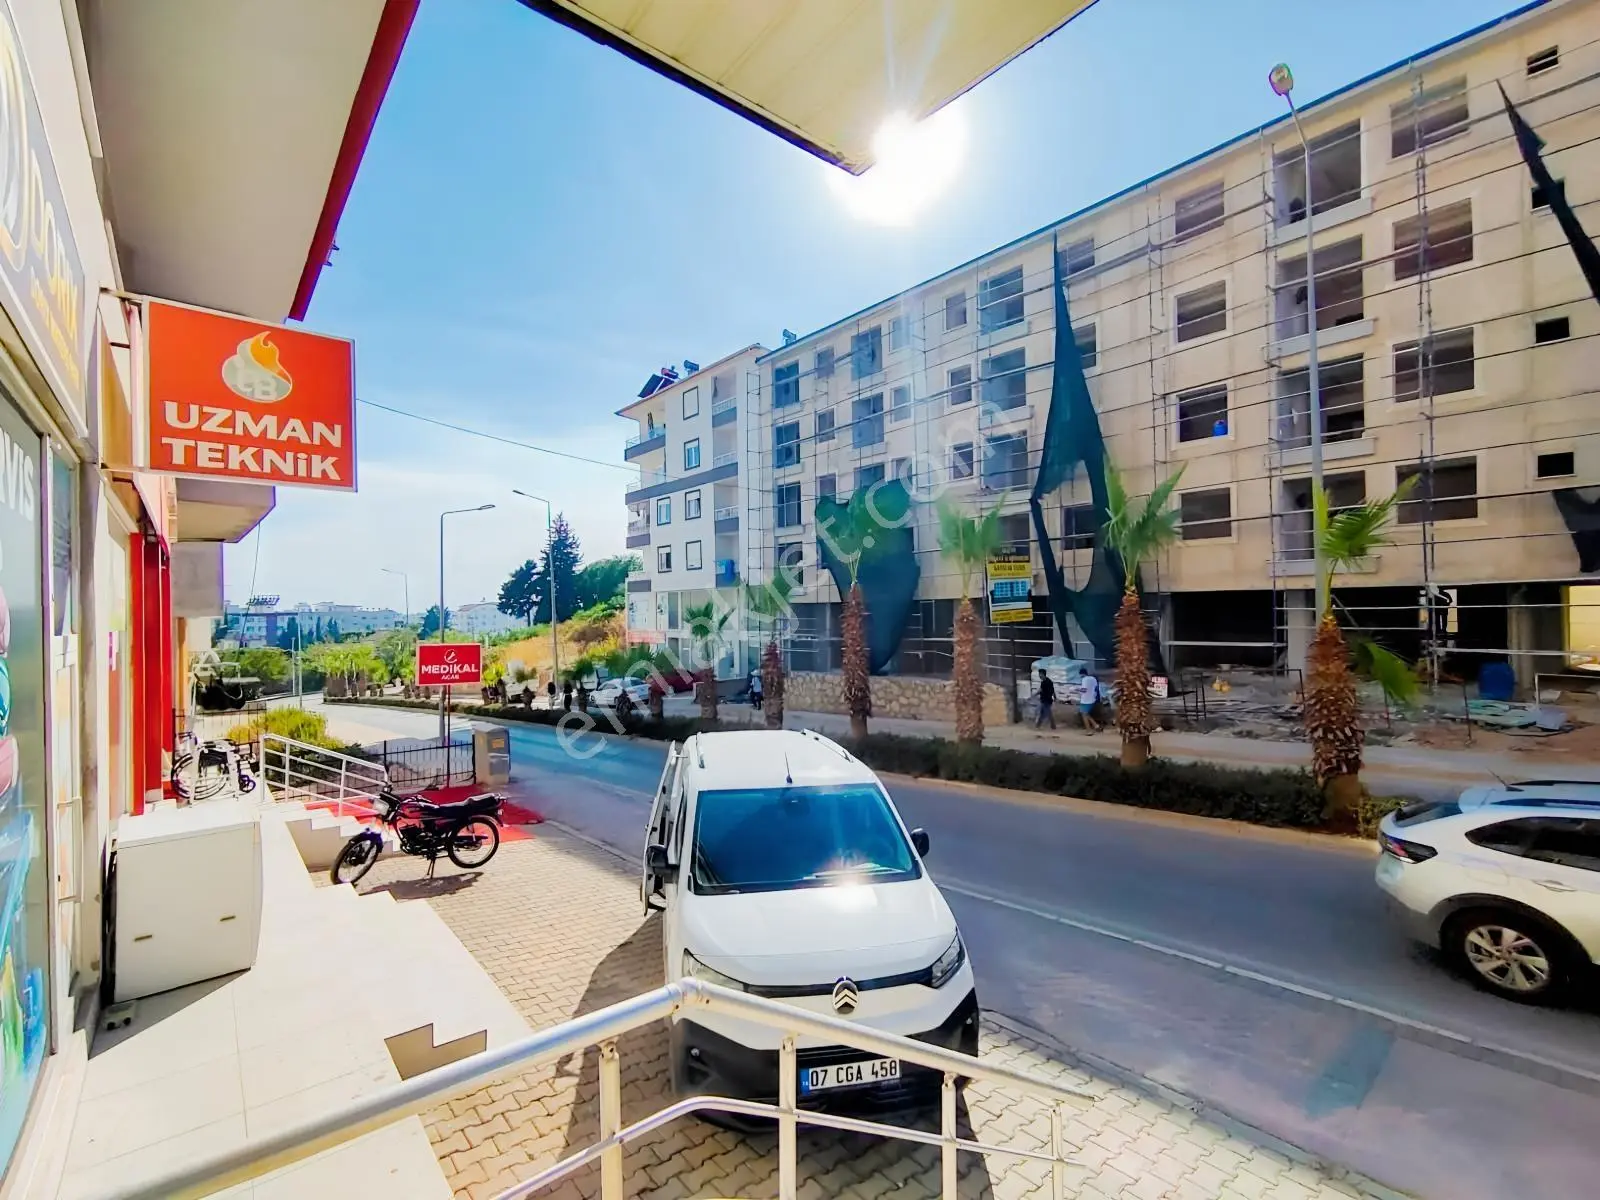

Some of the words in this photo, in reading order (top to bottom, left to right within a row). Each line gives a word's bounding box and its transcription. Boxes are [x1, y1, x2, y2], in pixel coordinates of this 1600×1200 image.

[164, 400, 342, 447] UZMAN
[811, 1069, 828, 1087] 07
[836, 1065, 863, 1083] CGA
[871, 1060, 897, 1078] 458
